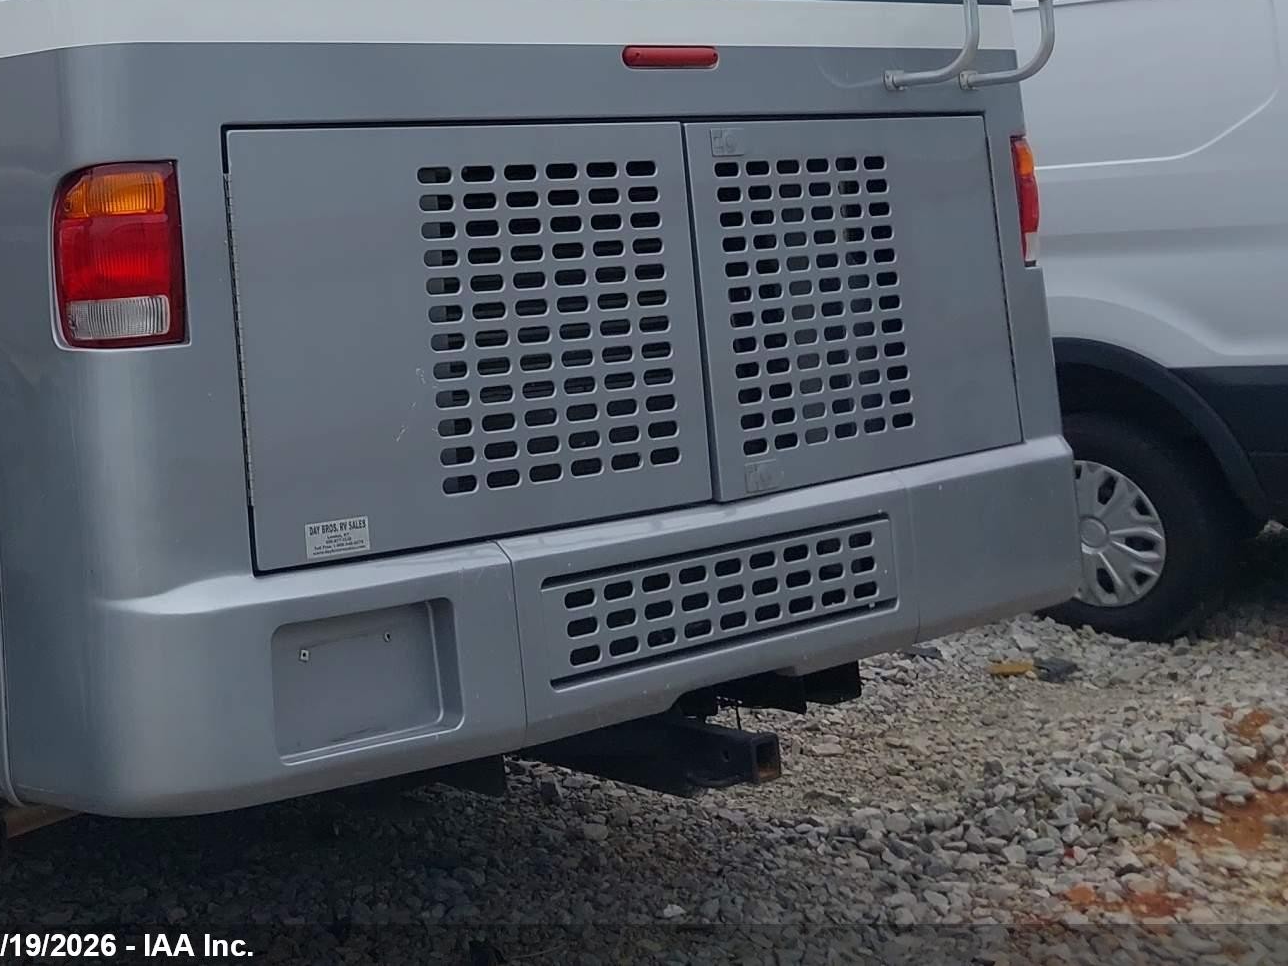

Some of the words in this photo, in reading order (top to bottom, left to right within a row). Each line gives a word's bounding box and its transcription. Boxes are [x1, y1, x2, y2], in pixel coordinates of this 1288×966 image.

[309, 526, 320, 536] DAY
[340, 521, 347, 531] RV
[349, 519, 366, 530] SALES
